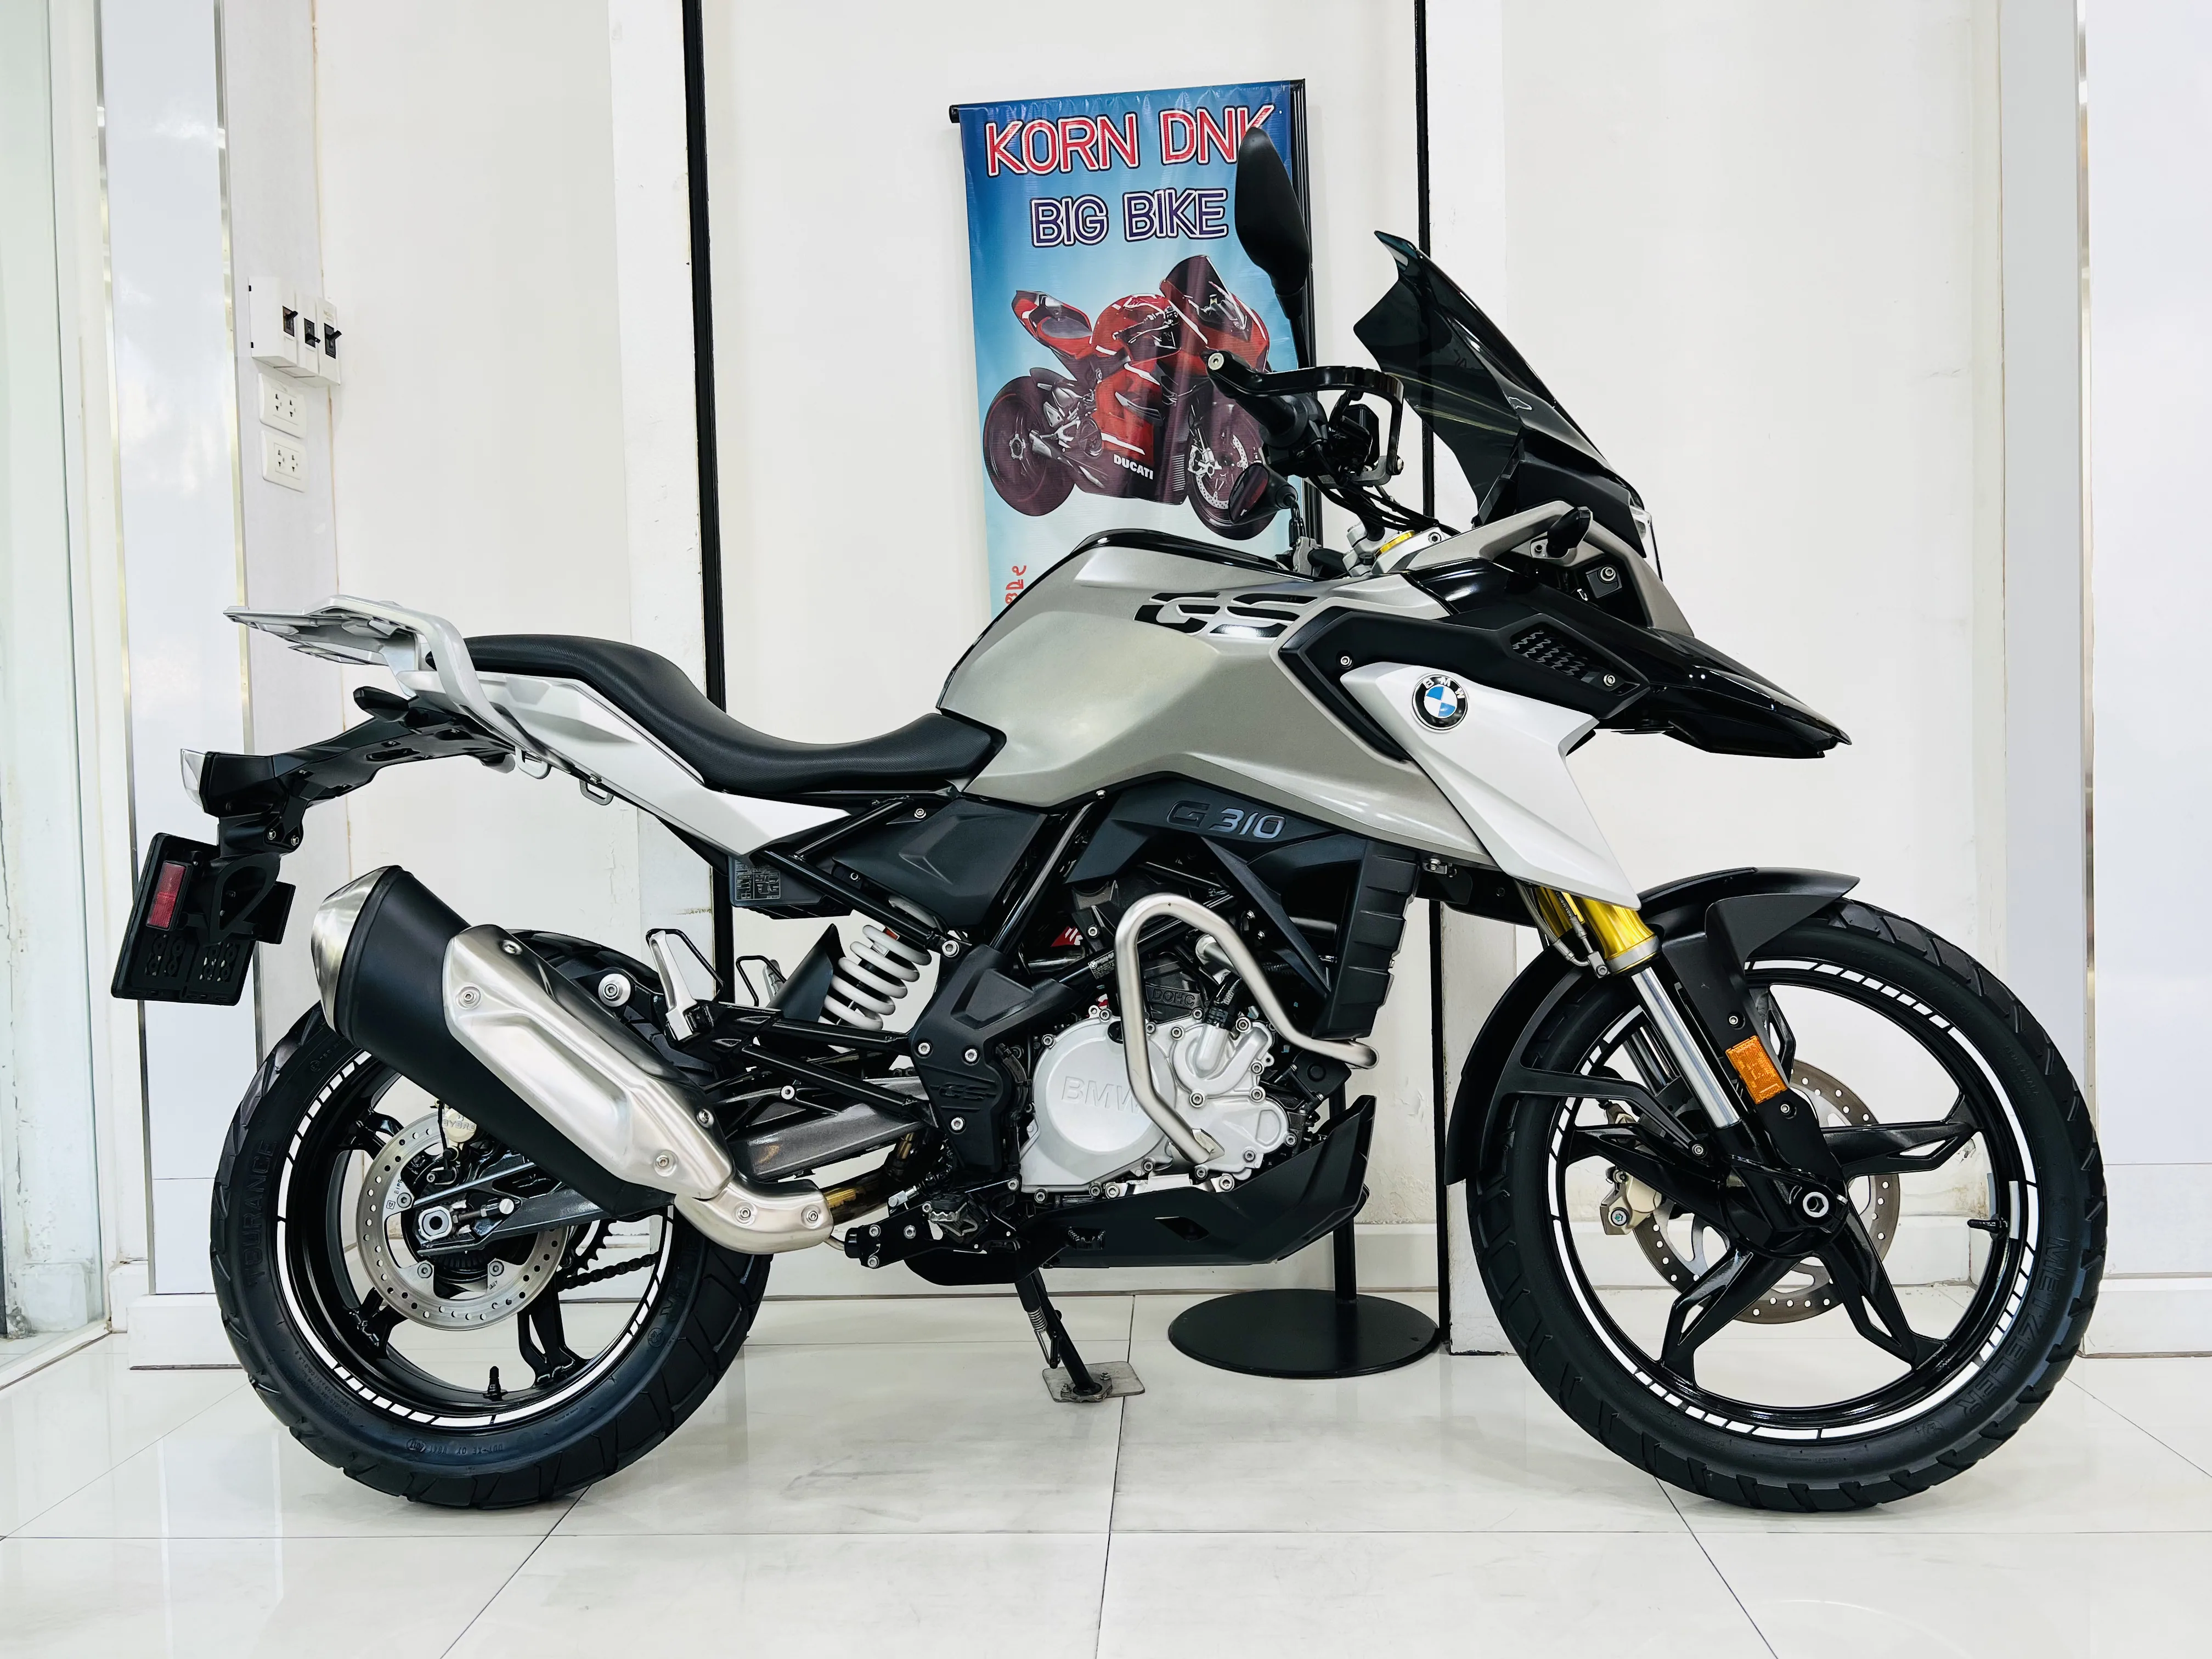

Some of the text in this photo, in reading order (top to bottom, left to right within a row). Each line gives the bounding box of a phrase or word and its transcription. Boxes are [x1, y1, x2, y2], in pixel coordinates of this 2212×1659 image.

[986, 112, 1138, 177] KORN
[1030, 188, 1228, 247] BIG BIKE
[1113, 454, 1154, 481] DUCATI
[1422, 676, 1465, 699] BMW
[1166, 800, 1286, 839] G 310
[1152, 988, 1196, 1007] DOHC
[442, 1119, 476, 1131] BYBRE
[241, 1138, 278, 1287] TOURANCE
[1955, 1237, 2071, 1414] METZELER
